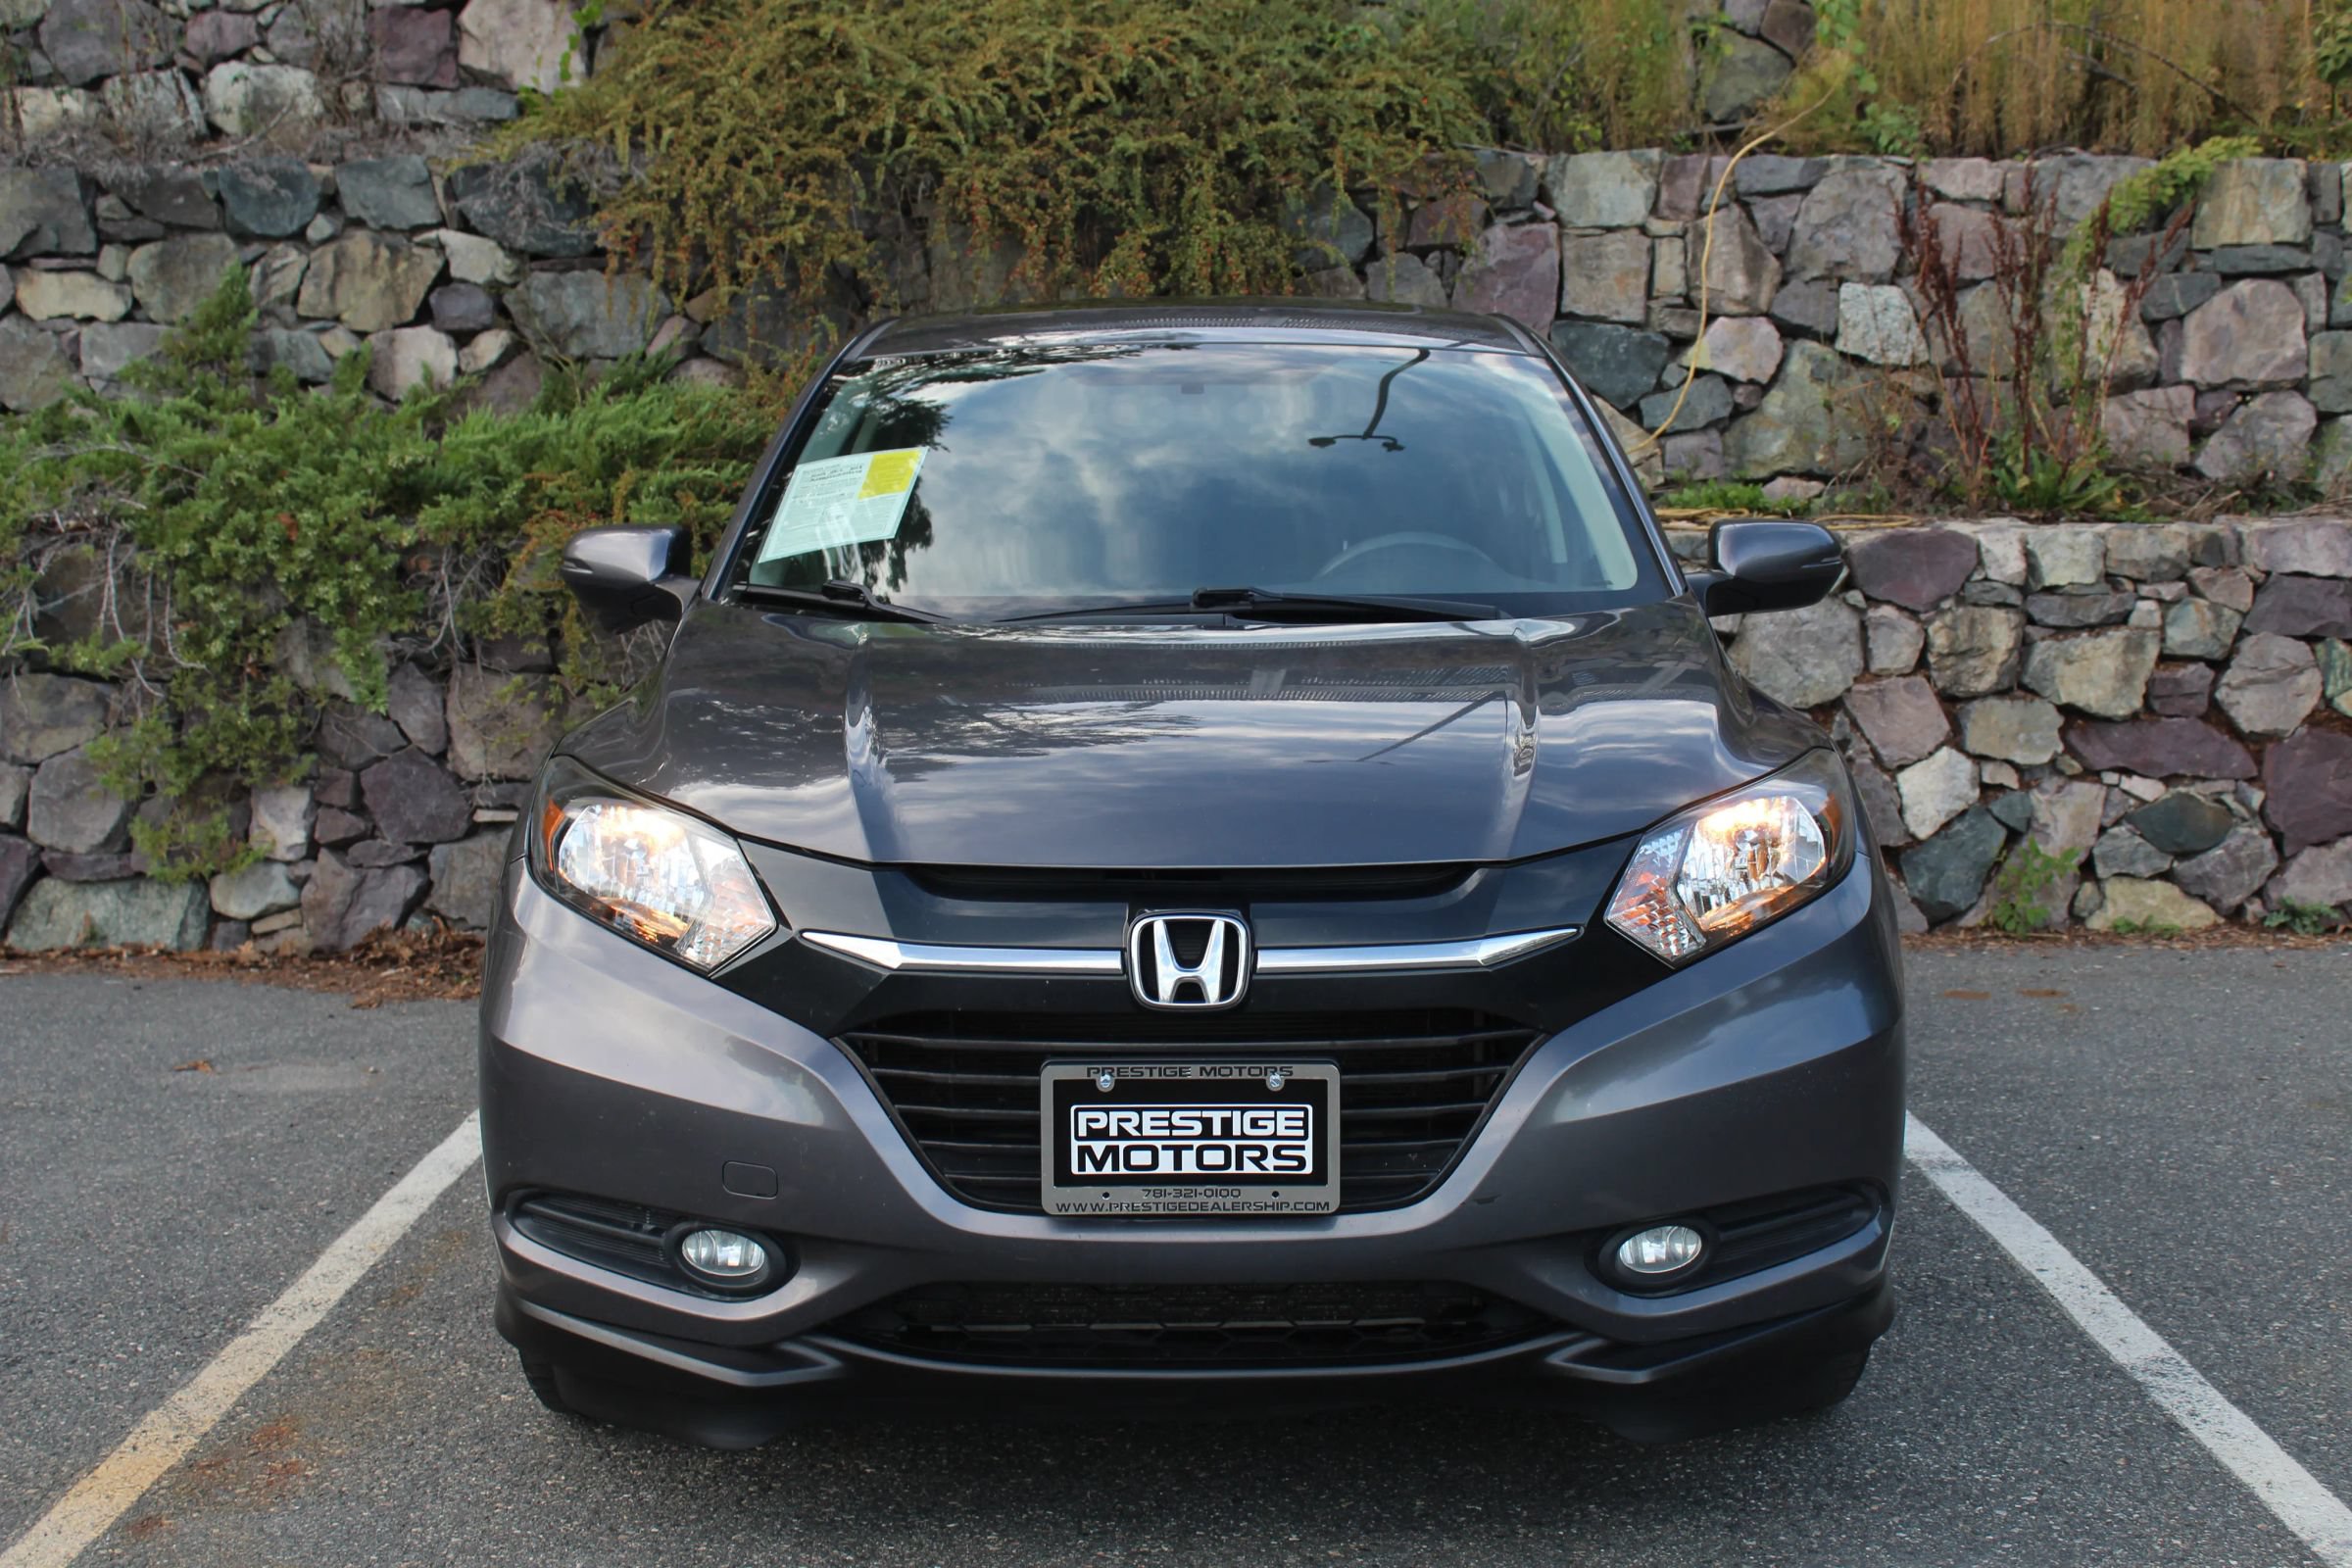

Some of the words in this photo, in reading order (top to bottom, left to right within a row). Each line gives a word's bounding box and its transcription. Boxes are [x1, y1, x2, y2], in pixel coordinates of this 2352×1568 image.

[1086, 1065, 1192, 1078] PRESTIGE
[1199, 1065, 1294, 1078] MOTORS
[1077, 1110, 1305, 1137] PRESTIGE
[1077, 1144, 1307, 1172] MOTORS
[1141, 1188, 1242, 1200] 781-321-0100
[1055, 1200, 1331, 1213] WWW.PRESTIGEDEALERSHIP.COM
